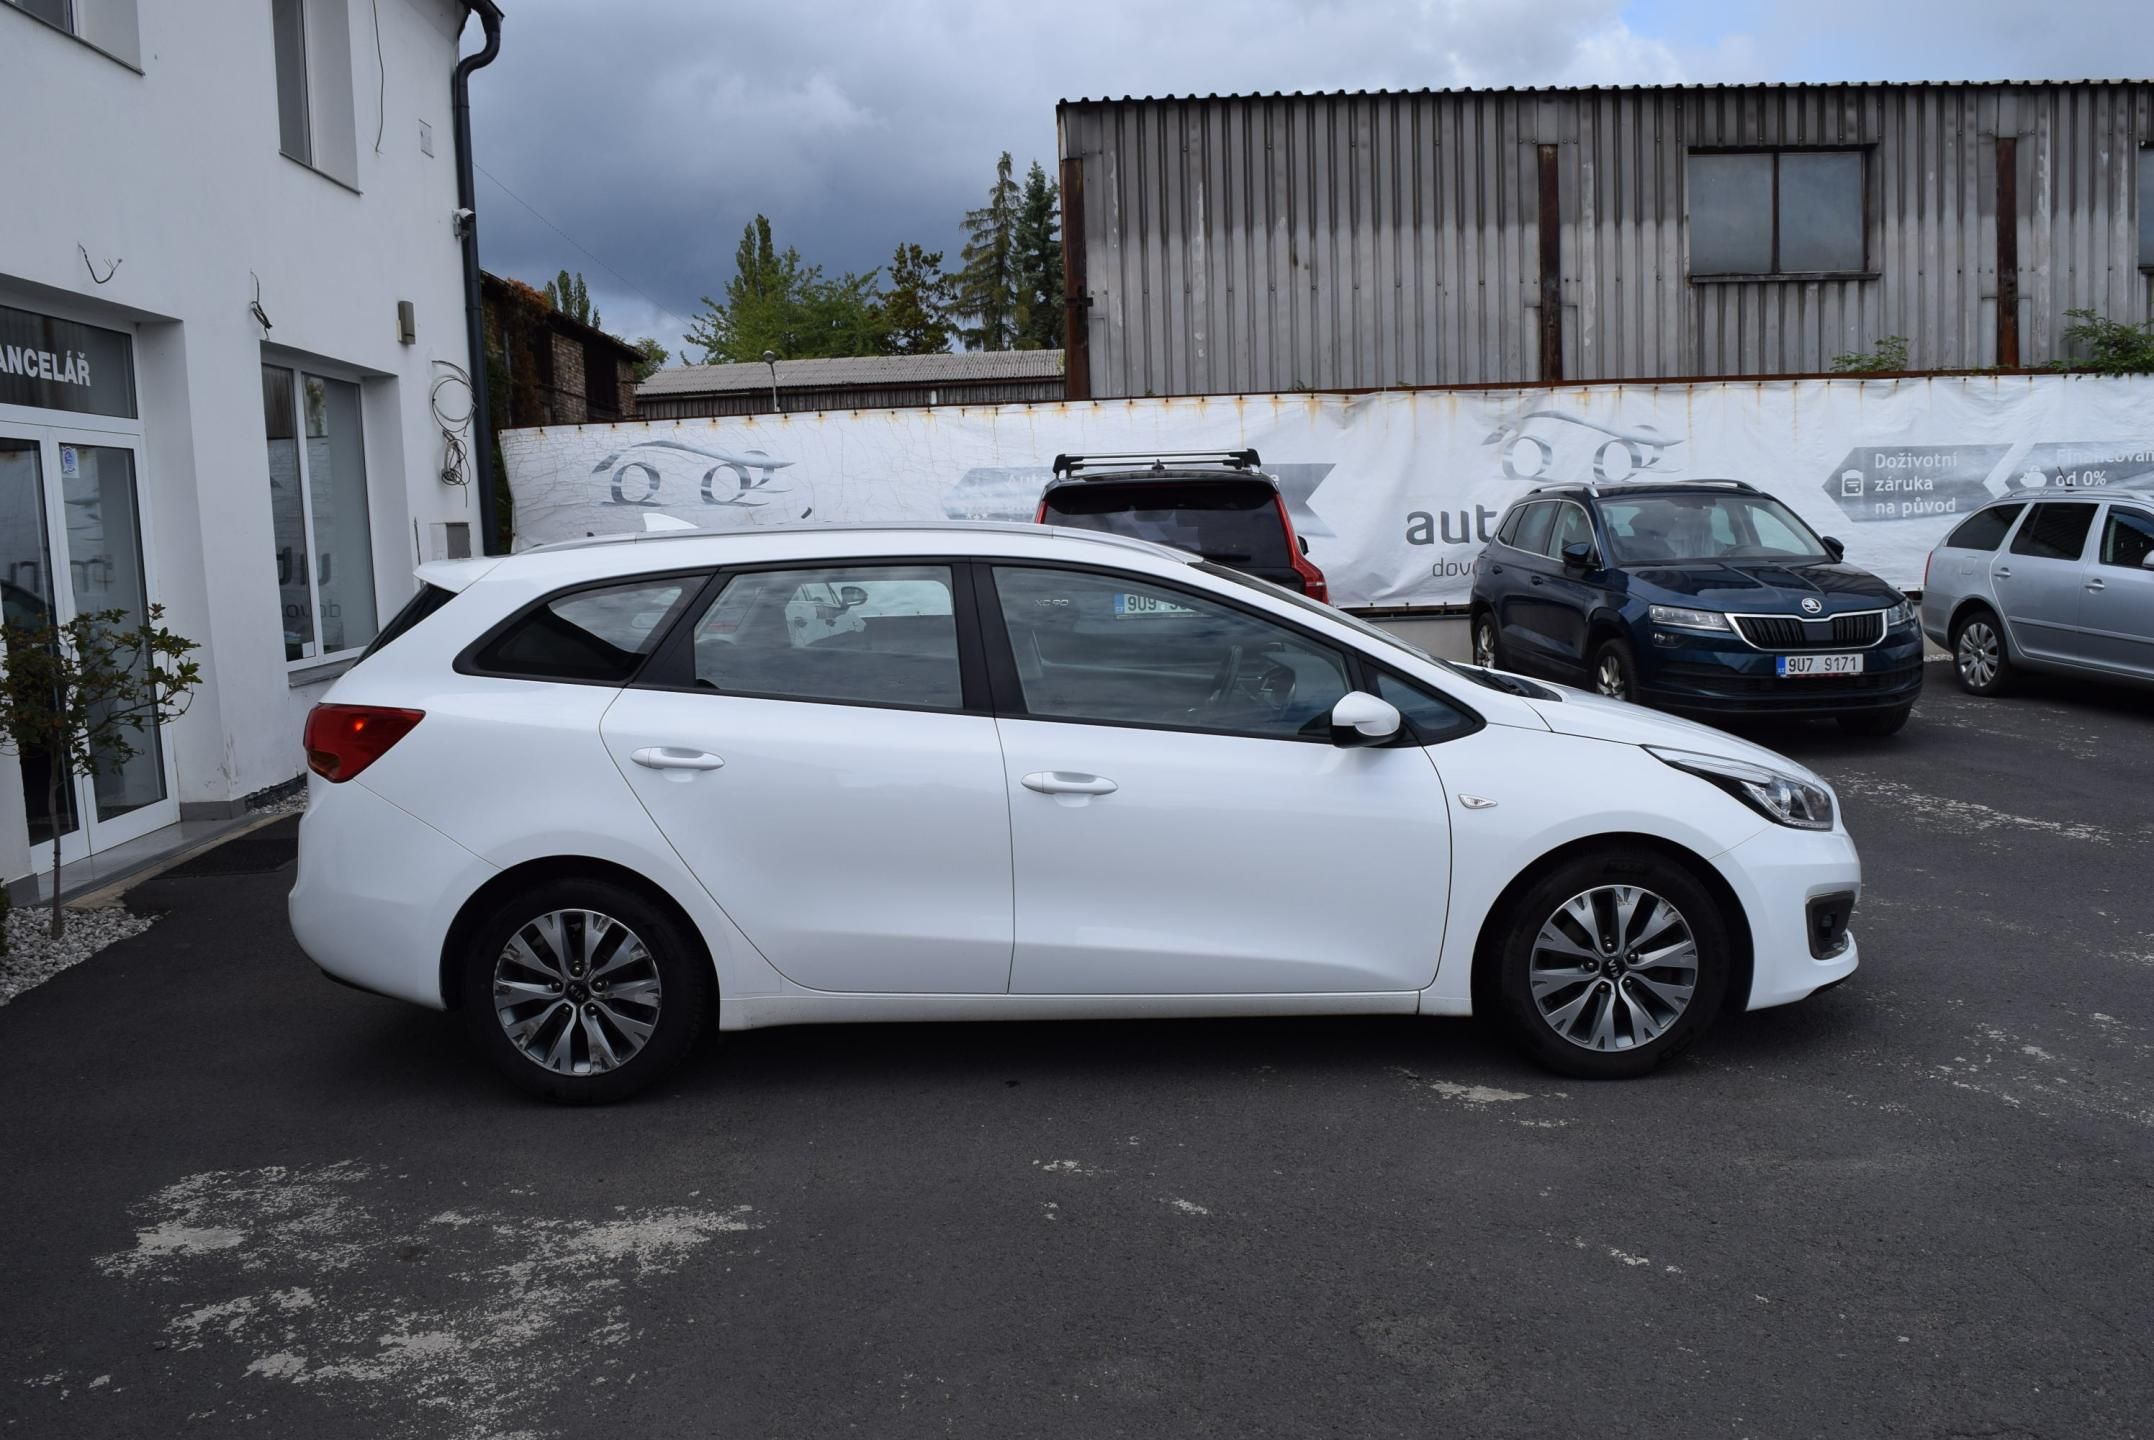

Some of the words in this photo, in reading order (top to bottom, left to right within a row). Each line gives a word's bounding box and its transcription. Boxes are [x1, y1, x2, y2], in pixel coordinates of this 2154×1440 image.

[1875, 451, 1958, 468] Doživotní
[1874, 475, 1934, 491] záruka
[2055, 471, 2076, 486] od
[2083, 470, 2107, 486] 0%
[1875, 502, 1896, 514] na
[1902, 496, 1956, 517] původ
[1788, 657, 1814, 672] 9U7
[1824, 656, 1857, 671] 9171
